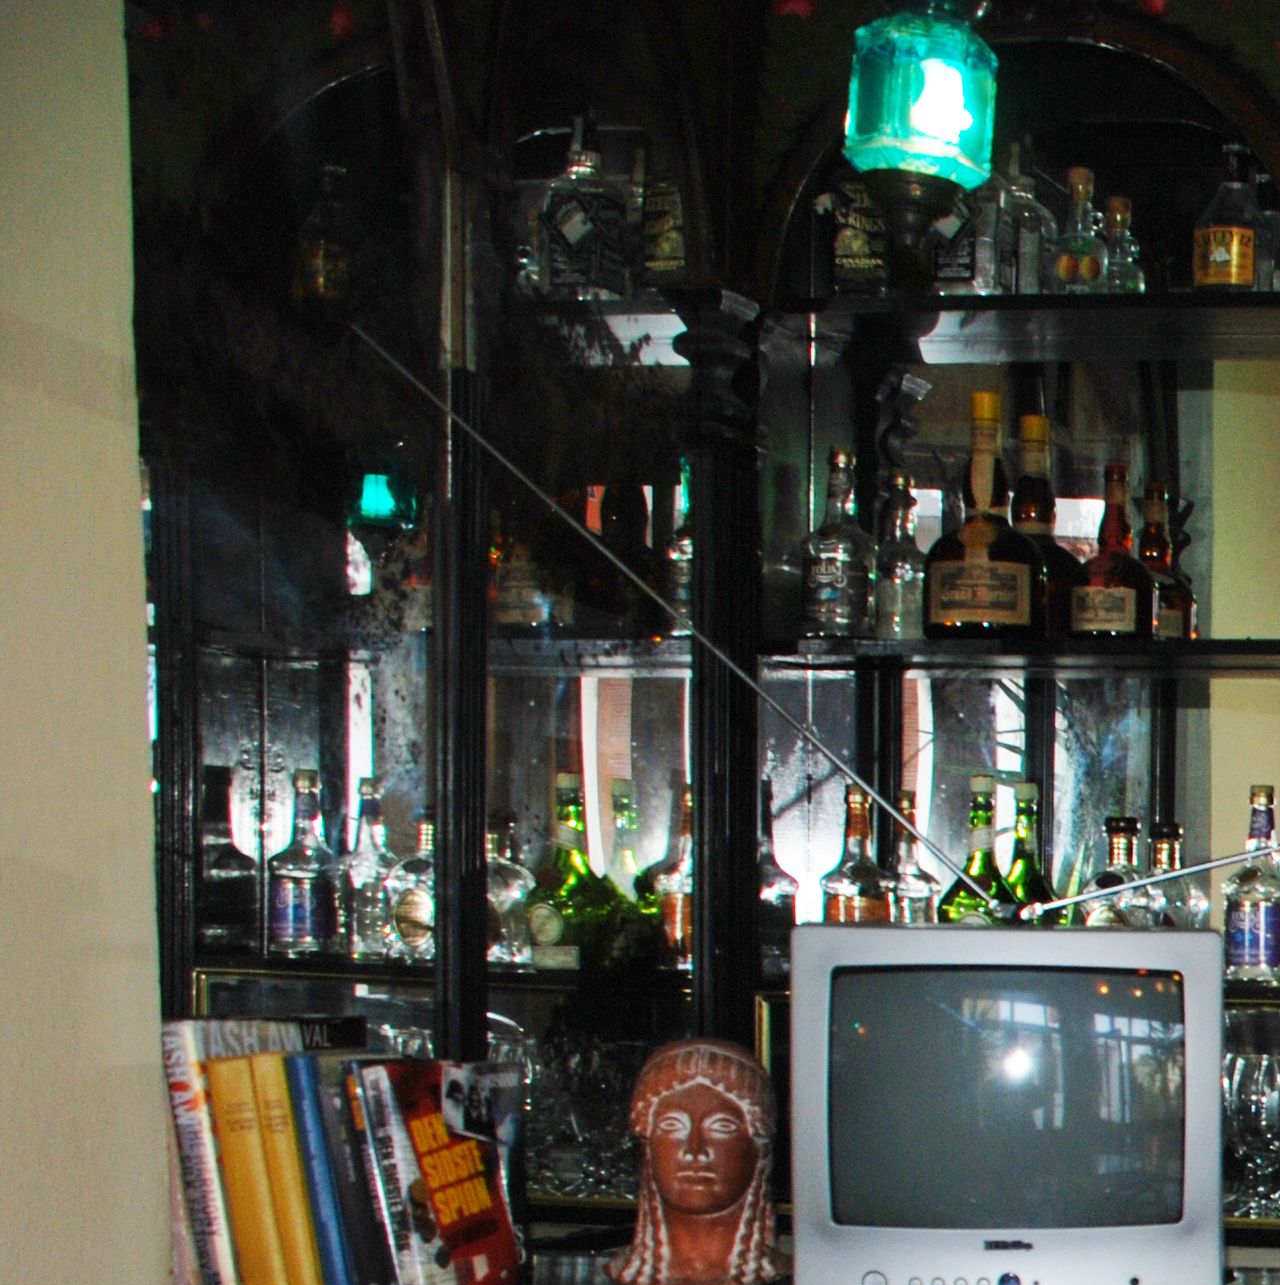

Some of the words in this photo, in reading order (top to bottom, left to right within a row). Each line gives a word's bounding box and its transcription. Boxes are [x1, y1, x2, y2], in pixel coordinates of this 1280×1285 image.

[409, 1112, 449, 1153] DEN
[420, 1139, 485, 1190] SIDSTE
[433, 1175, 492, 1226] SPION
